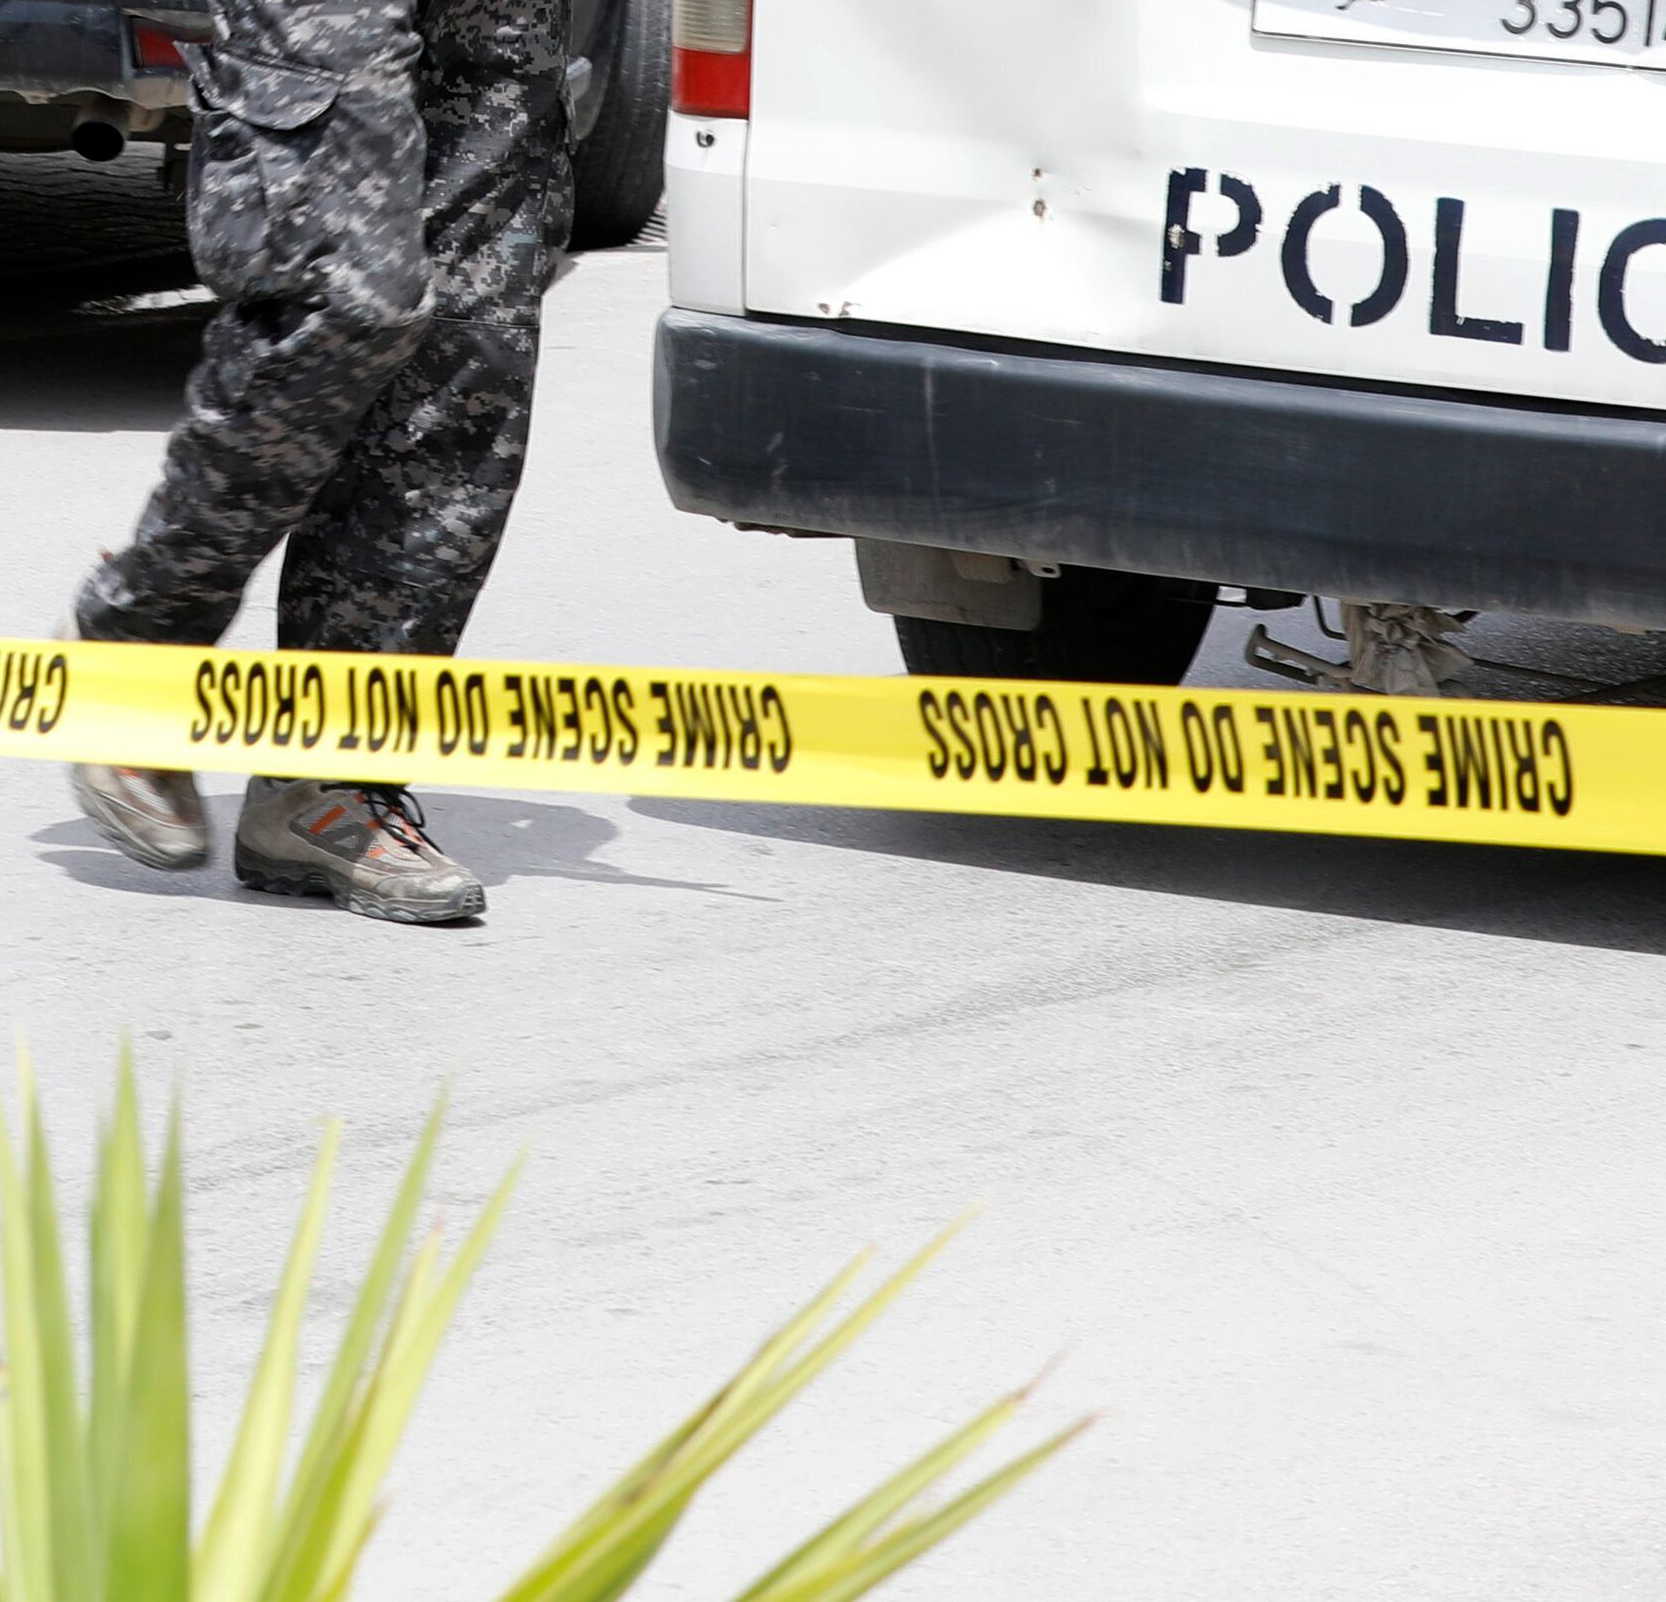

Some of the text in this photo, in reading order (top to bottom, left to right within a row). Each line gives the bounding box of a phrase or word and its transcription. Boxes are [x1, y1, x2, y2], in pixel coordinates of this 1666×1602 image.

[190, 659, 792, 773] CRIME SCENE DO NOT CROSS
[917, 689, 1574, 817] CRIME SCENE DO NOT CROSS
